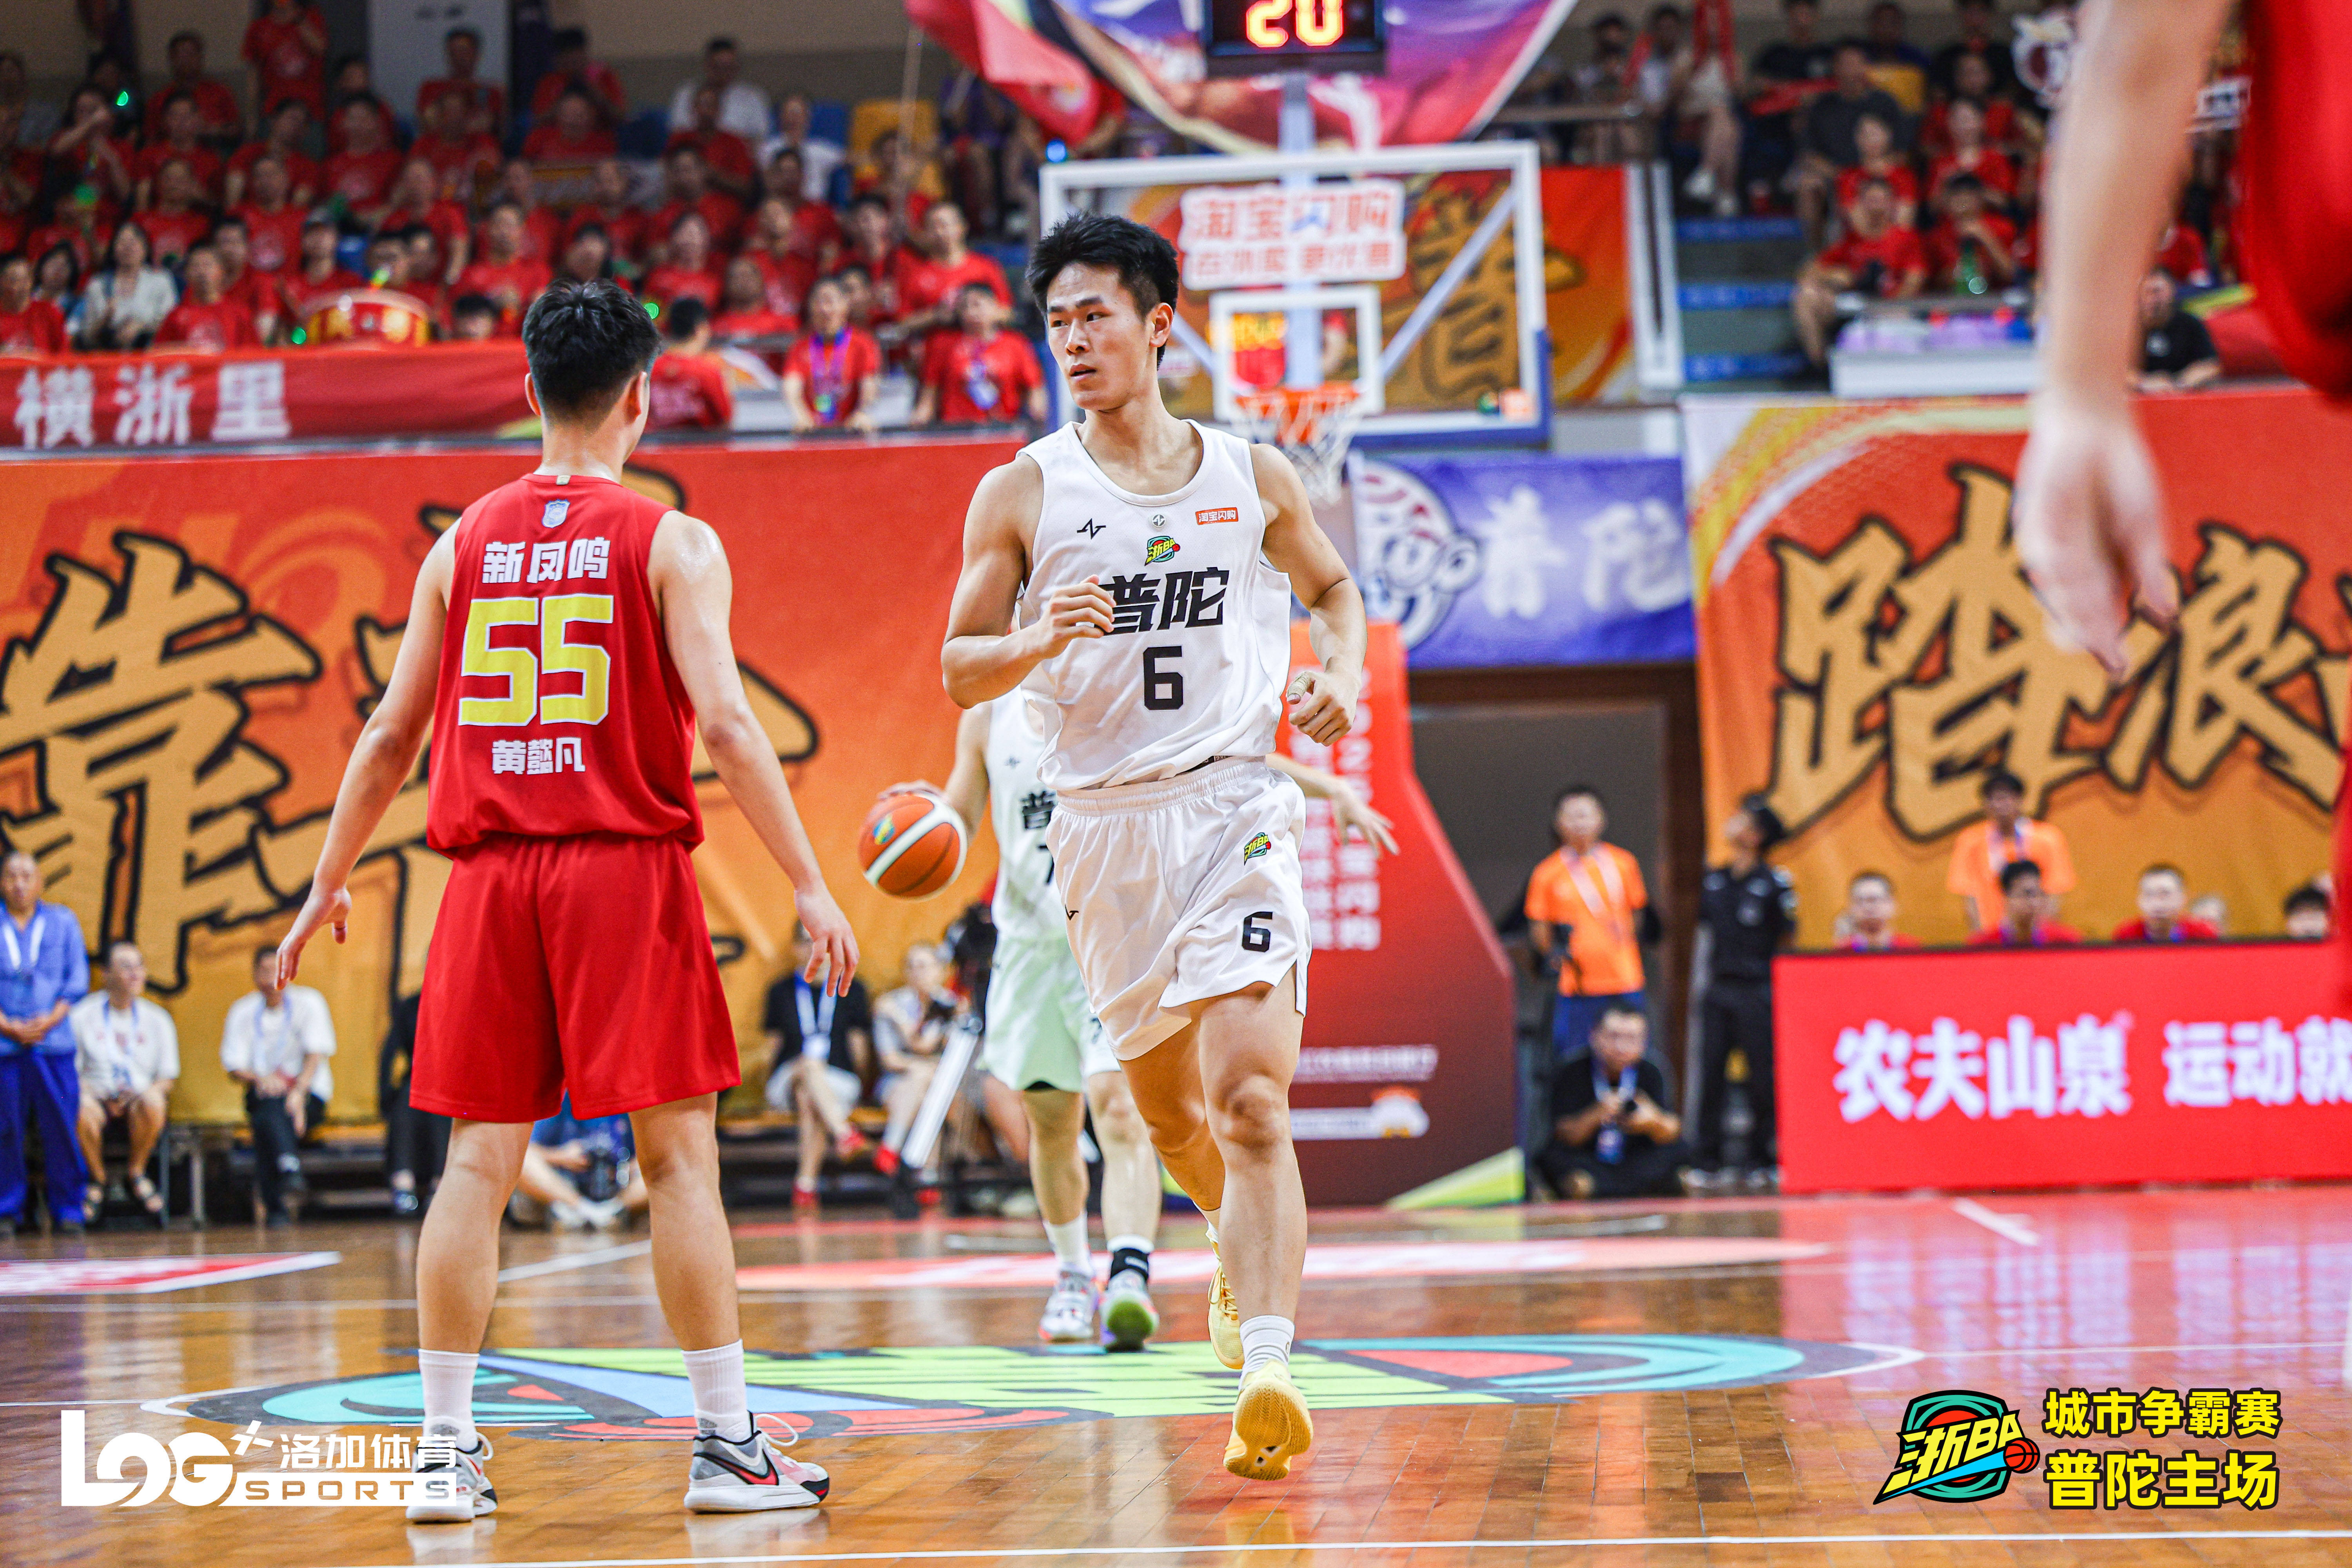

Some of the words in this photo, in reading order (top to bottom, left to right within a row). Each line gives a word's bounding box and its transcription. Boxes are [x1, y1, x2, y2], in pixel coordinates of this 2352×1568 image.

[1246, 0, 1344, 47] 20
[15, 361, 292, 450] 横浙里
[1198, 510, 1236, 523] 淘宝闪购
[482, 536, 611, 584] 新凤鸣
[1094, 567, 1230, 636] 普陀
[458, 593, 614, 727] 55
[1143, 646, 1183, 711] 6
[1771, 462, 2352, 843] 踏浪
[1242, 911, 1273, 952] 6
[1833, 1014, 2132, 1123] 农夫山泉
[2162, 1015, 2352, 1108] 运动就
